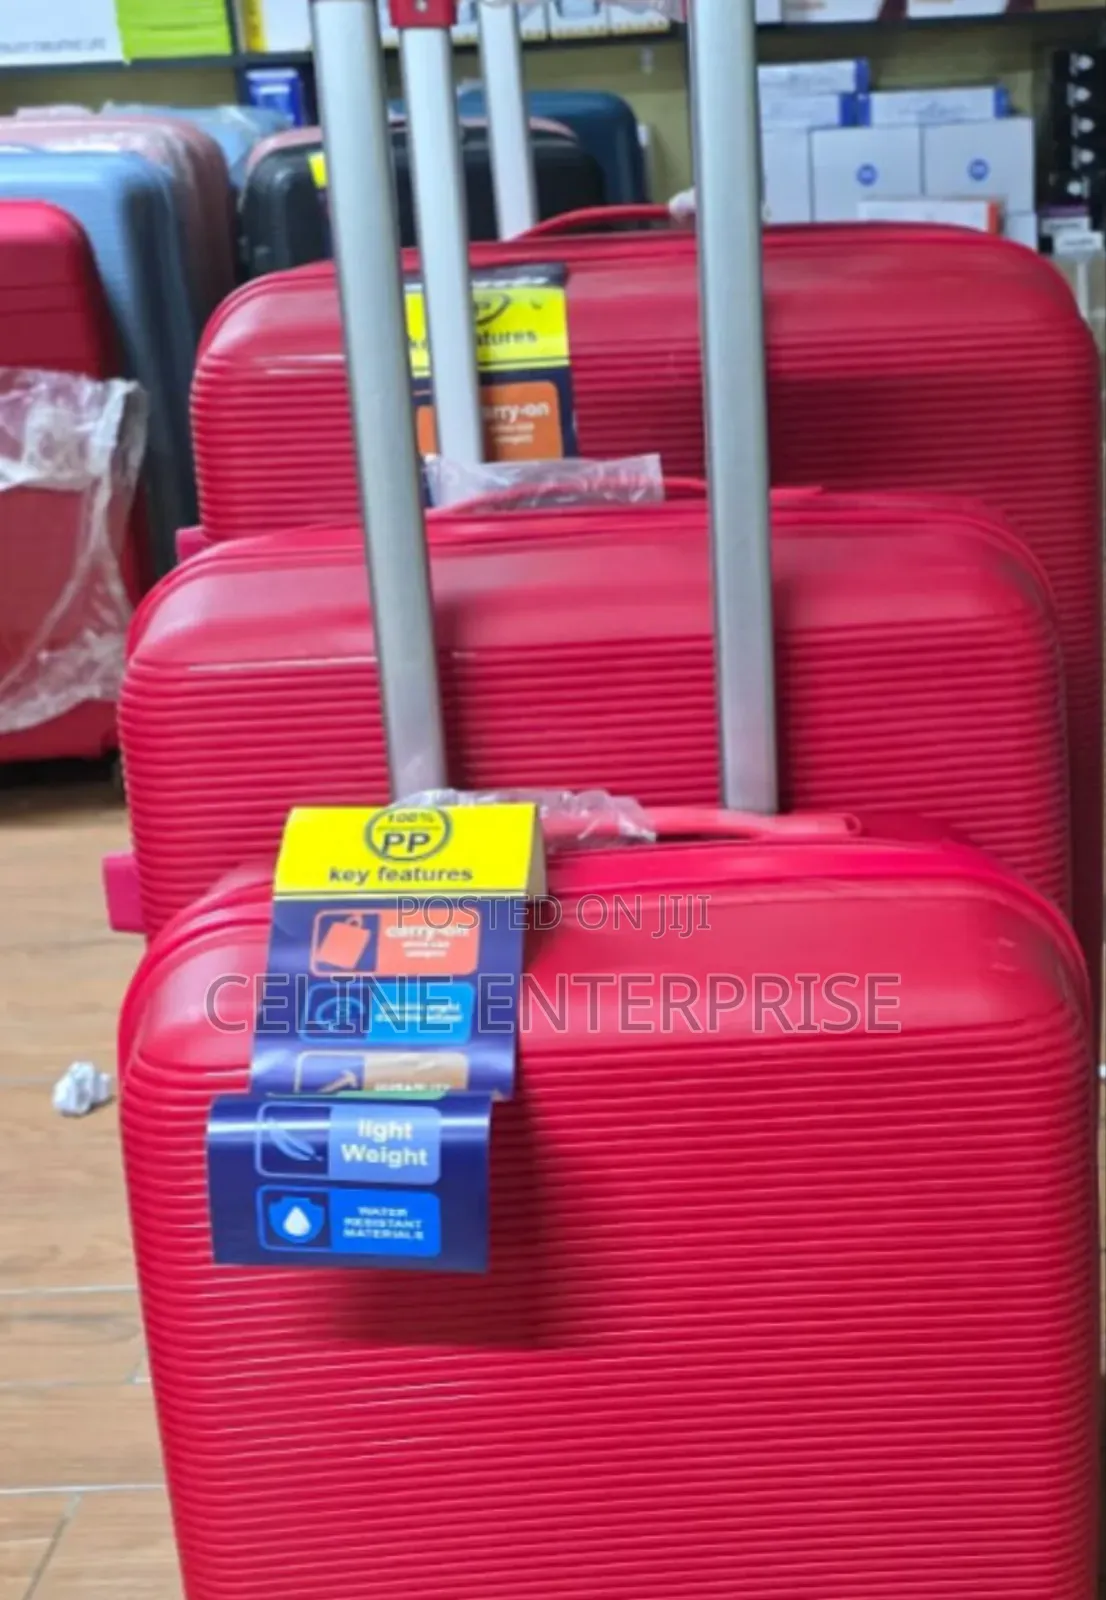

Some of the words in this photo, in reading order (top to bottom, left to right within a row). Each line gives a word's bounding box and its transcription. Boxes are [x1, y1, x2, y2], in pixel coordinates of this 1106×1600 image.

[381, 831, 431, 855] PP
[328, 866, 370, 886] key
[377, 866, 473, 883] features
[357, 1118, 414, 1143] light
[341, 1143, 428, 1169] Weight
